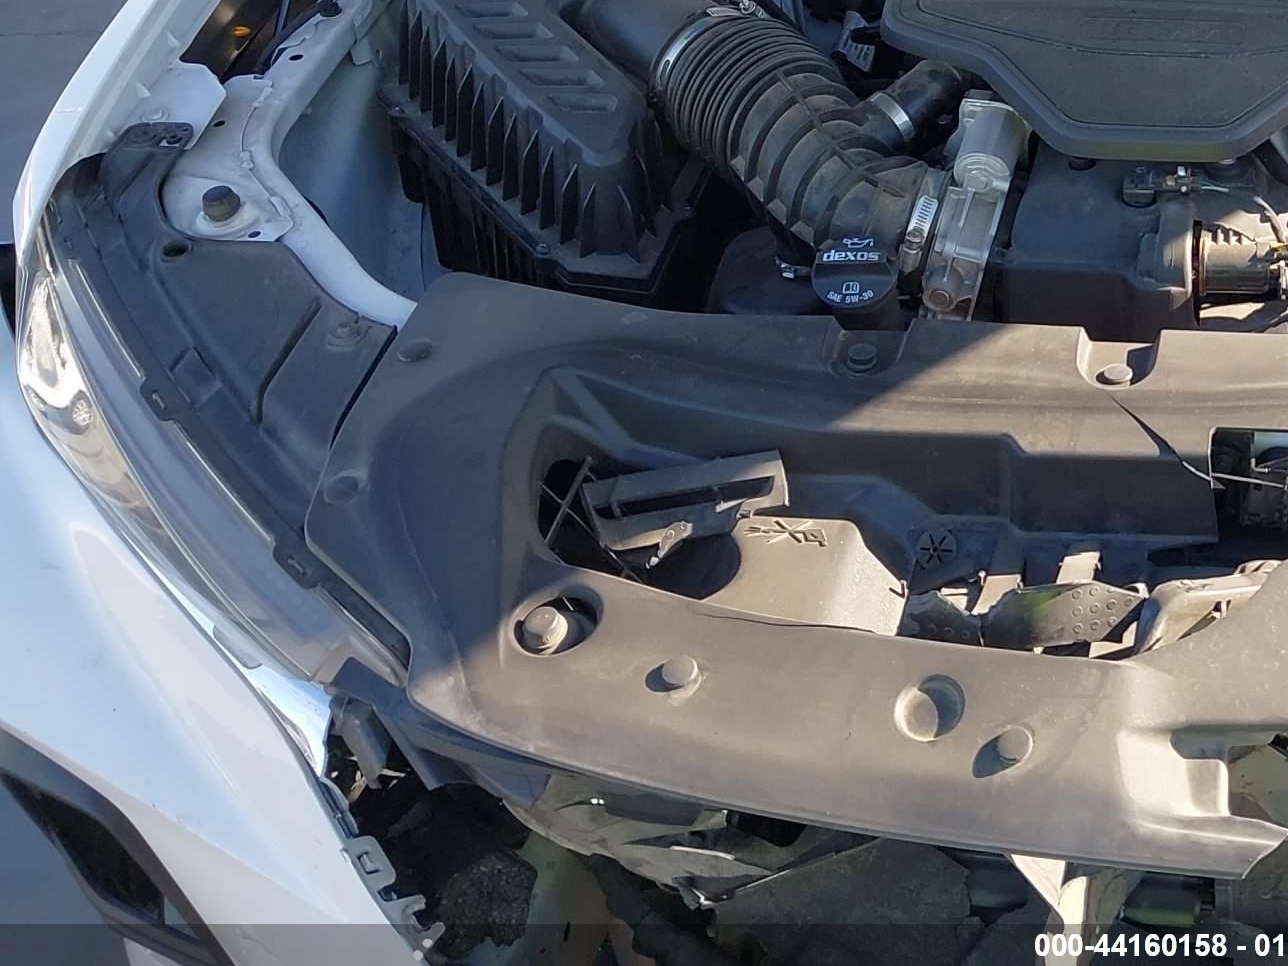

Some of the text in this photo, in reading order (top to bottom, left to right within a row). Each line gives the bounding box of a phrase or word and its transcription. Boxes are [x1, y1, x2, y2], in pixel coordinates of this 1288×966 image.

[822, 249, 881, 262] dexos
[826, 289, 874, 304] SAE 5W-30
